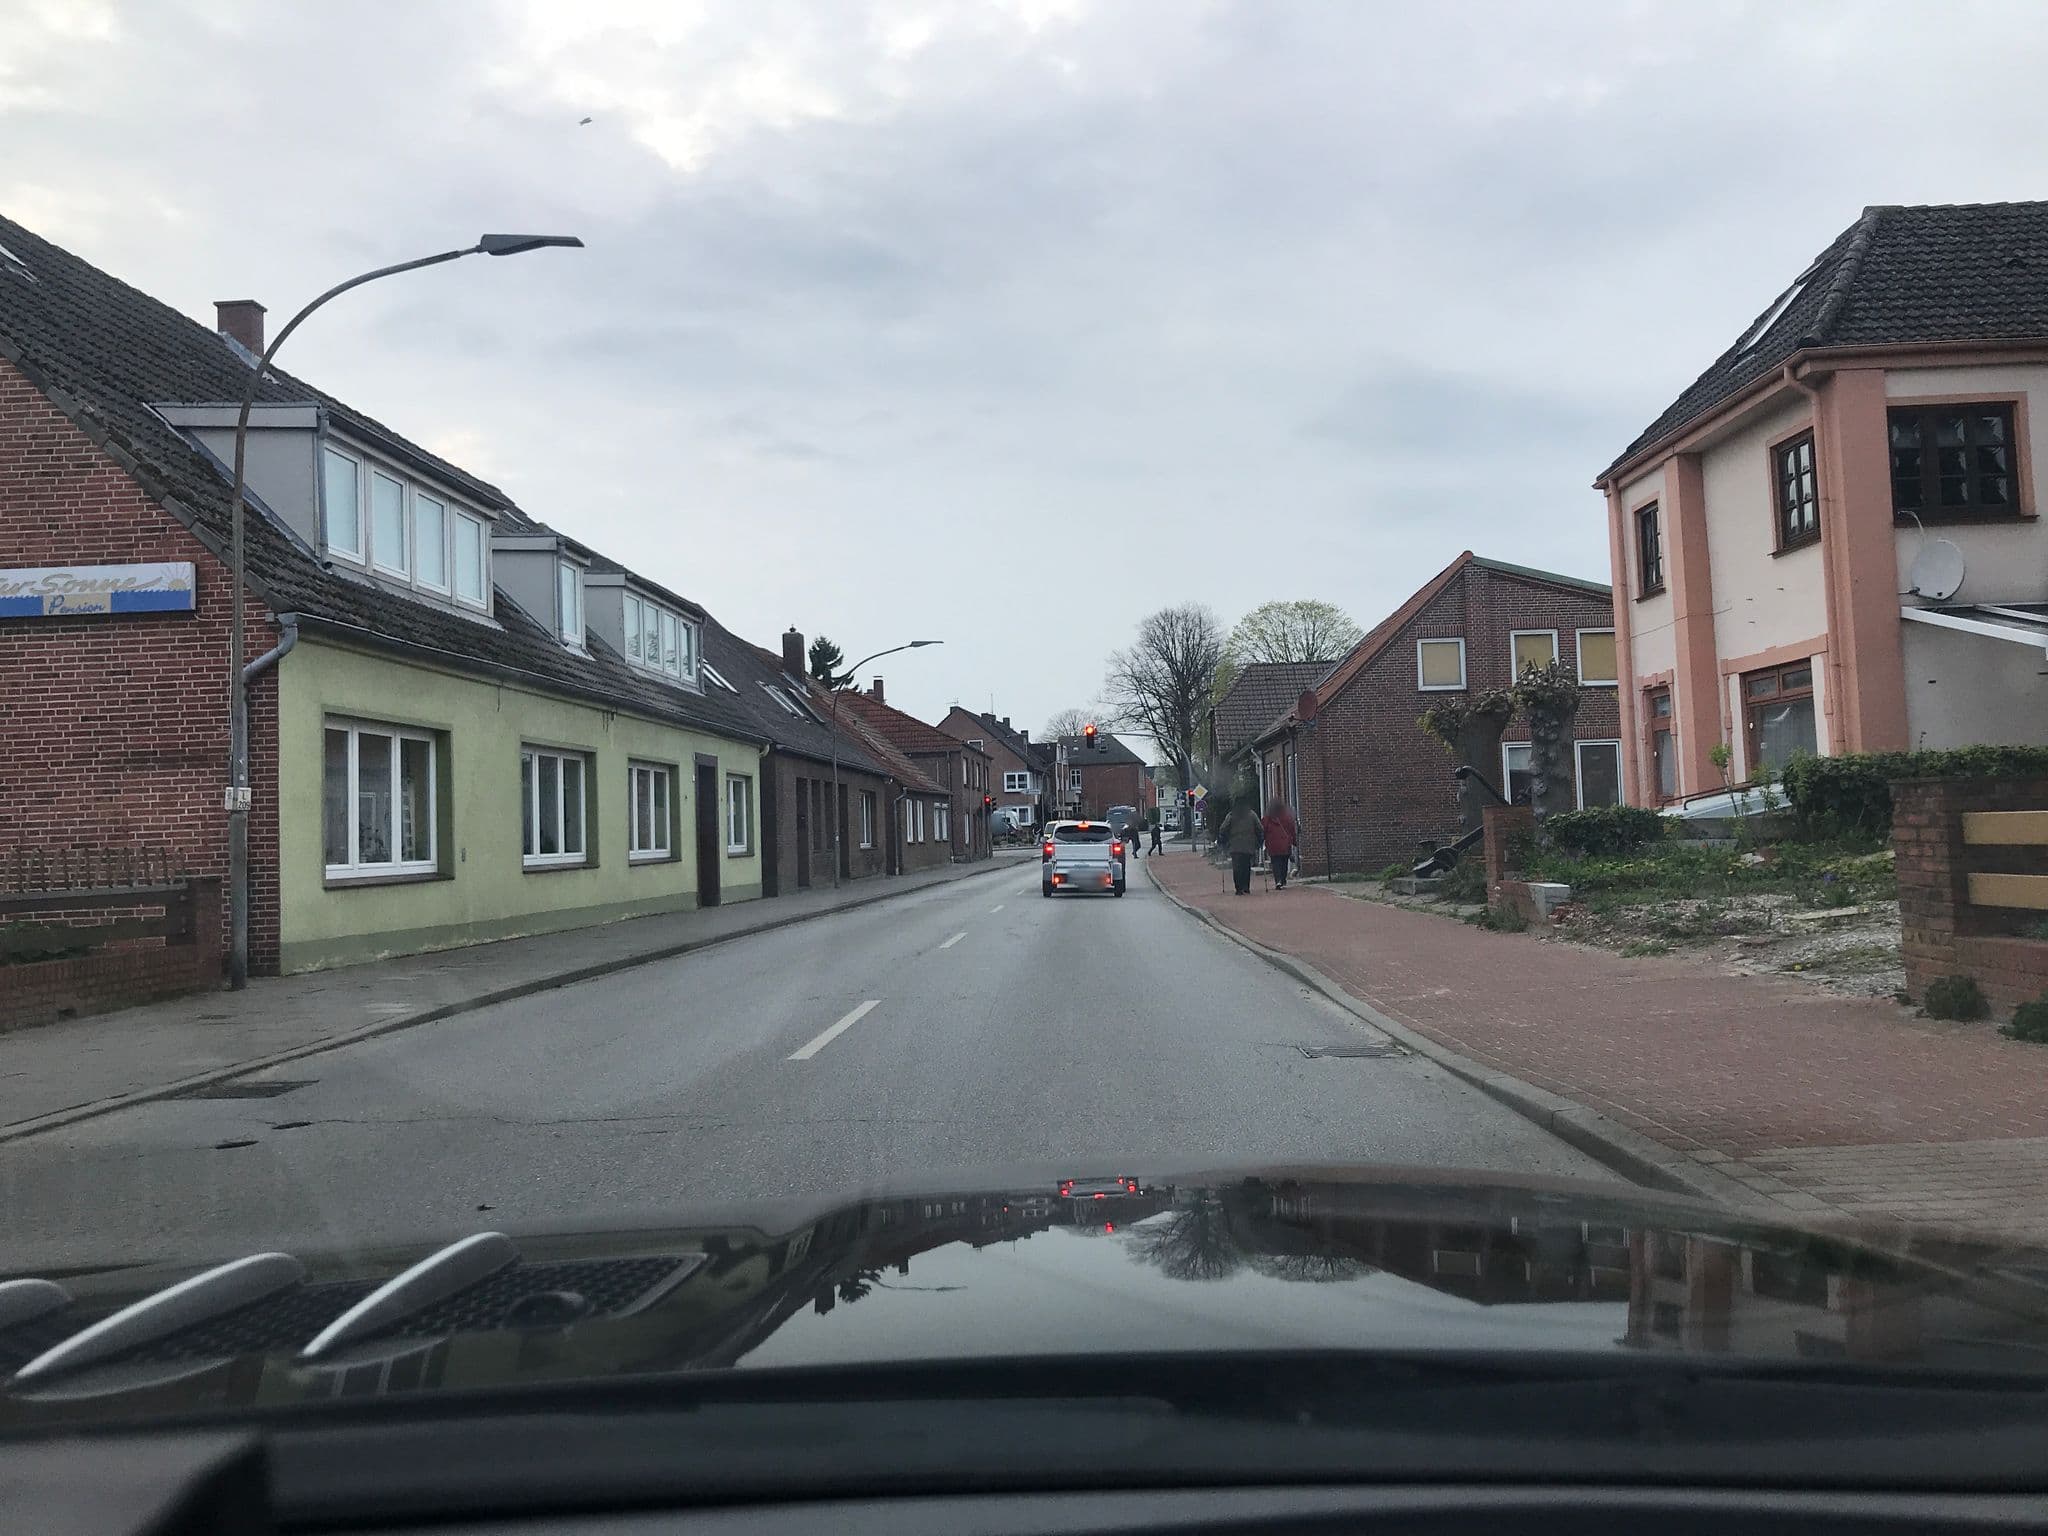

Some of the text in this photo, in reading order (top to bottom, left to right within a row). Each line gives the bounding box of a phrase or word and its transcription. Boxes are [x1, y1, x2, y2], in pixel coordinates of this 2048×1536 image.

[0, 573, 163, 595] ur Sonne
[49, 594, 105, 614] Pension
